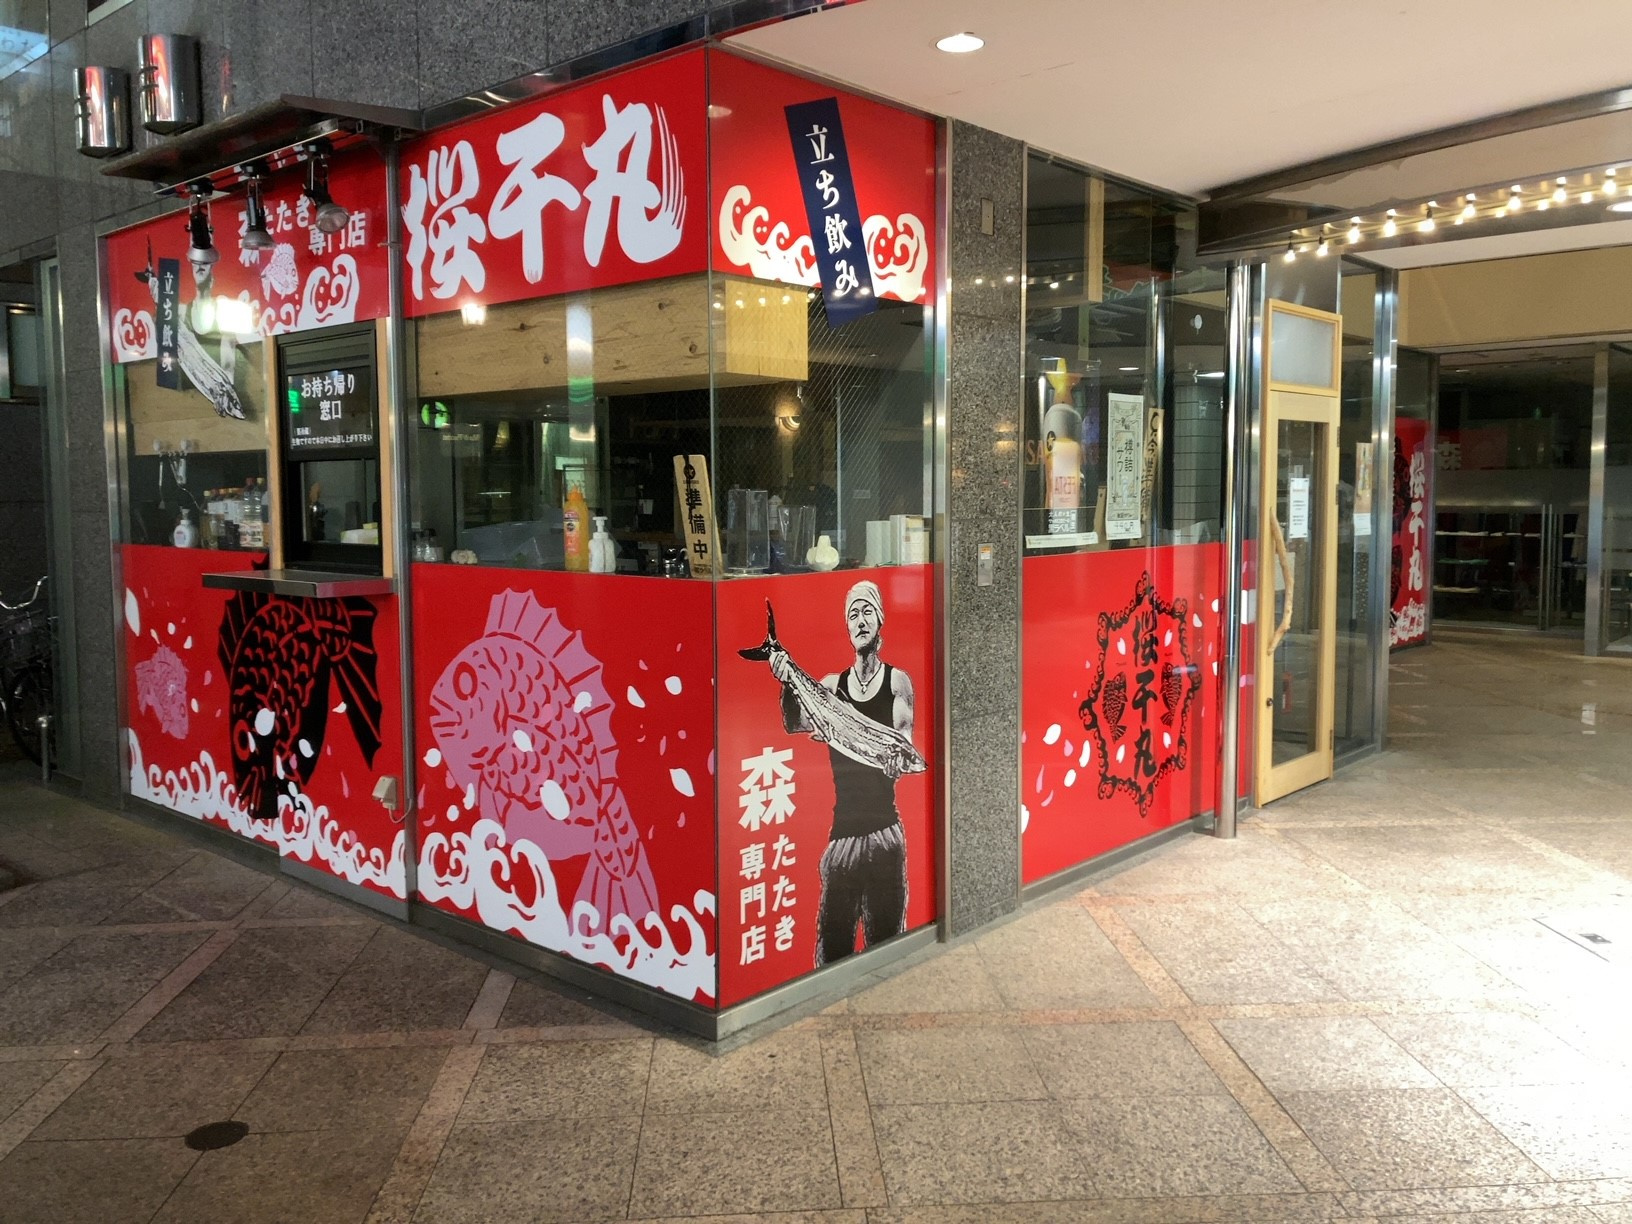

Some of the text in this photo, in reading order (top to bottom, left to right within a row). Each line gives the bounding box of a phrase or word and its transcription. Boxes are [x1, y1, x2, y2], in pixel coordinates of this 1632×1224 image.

[805, 124, 859, 296] 立ち飲み
[301, 373, 355, 398] お持ち帰り
[319, 399, 342, 421] 窓口
[685, 488, 709, 560] 準備中
[738, 747, 796, 832] 森
[739, 843, 766, 966] 専門店
[772, 834, 796, 951] たたき
